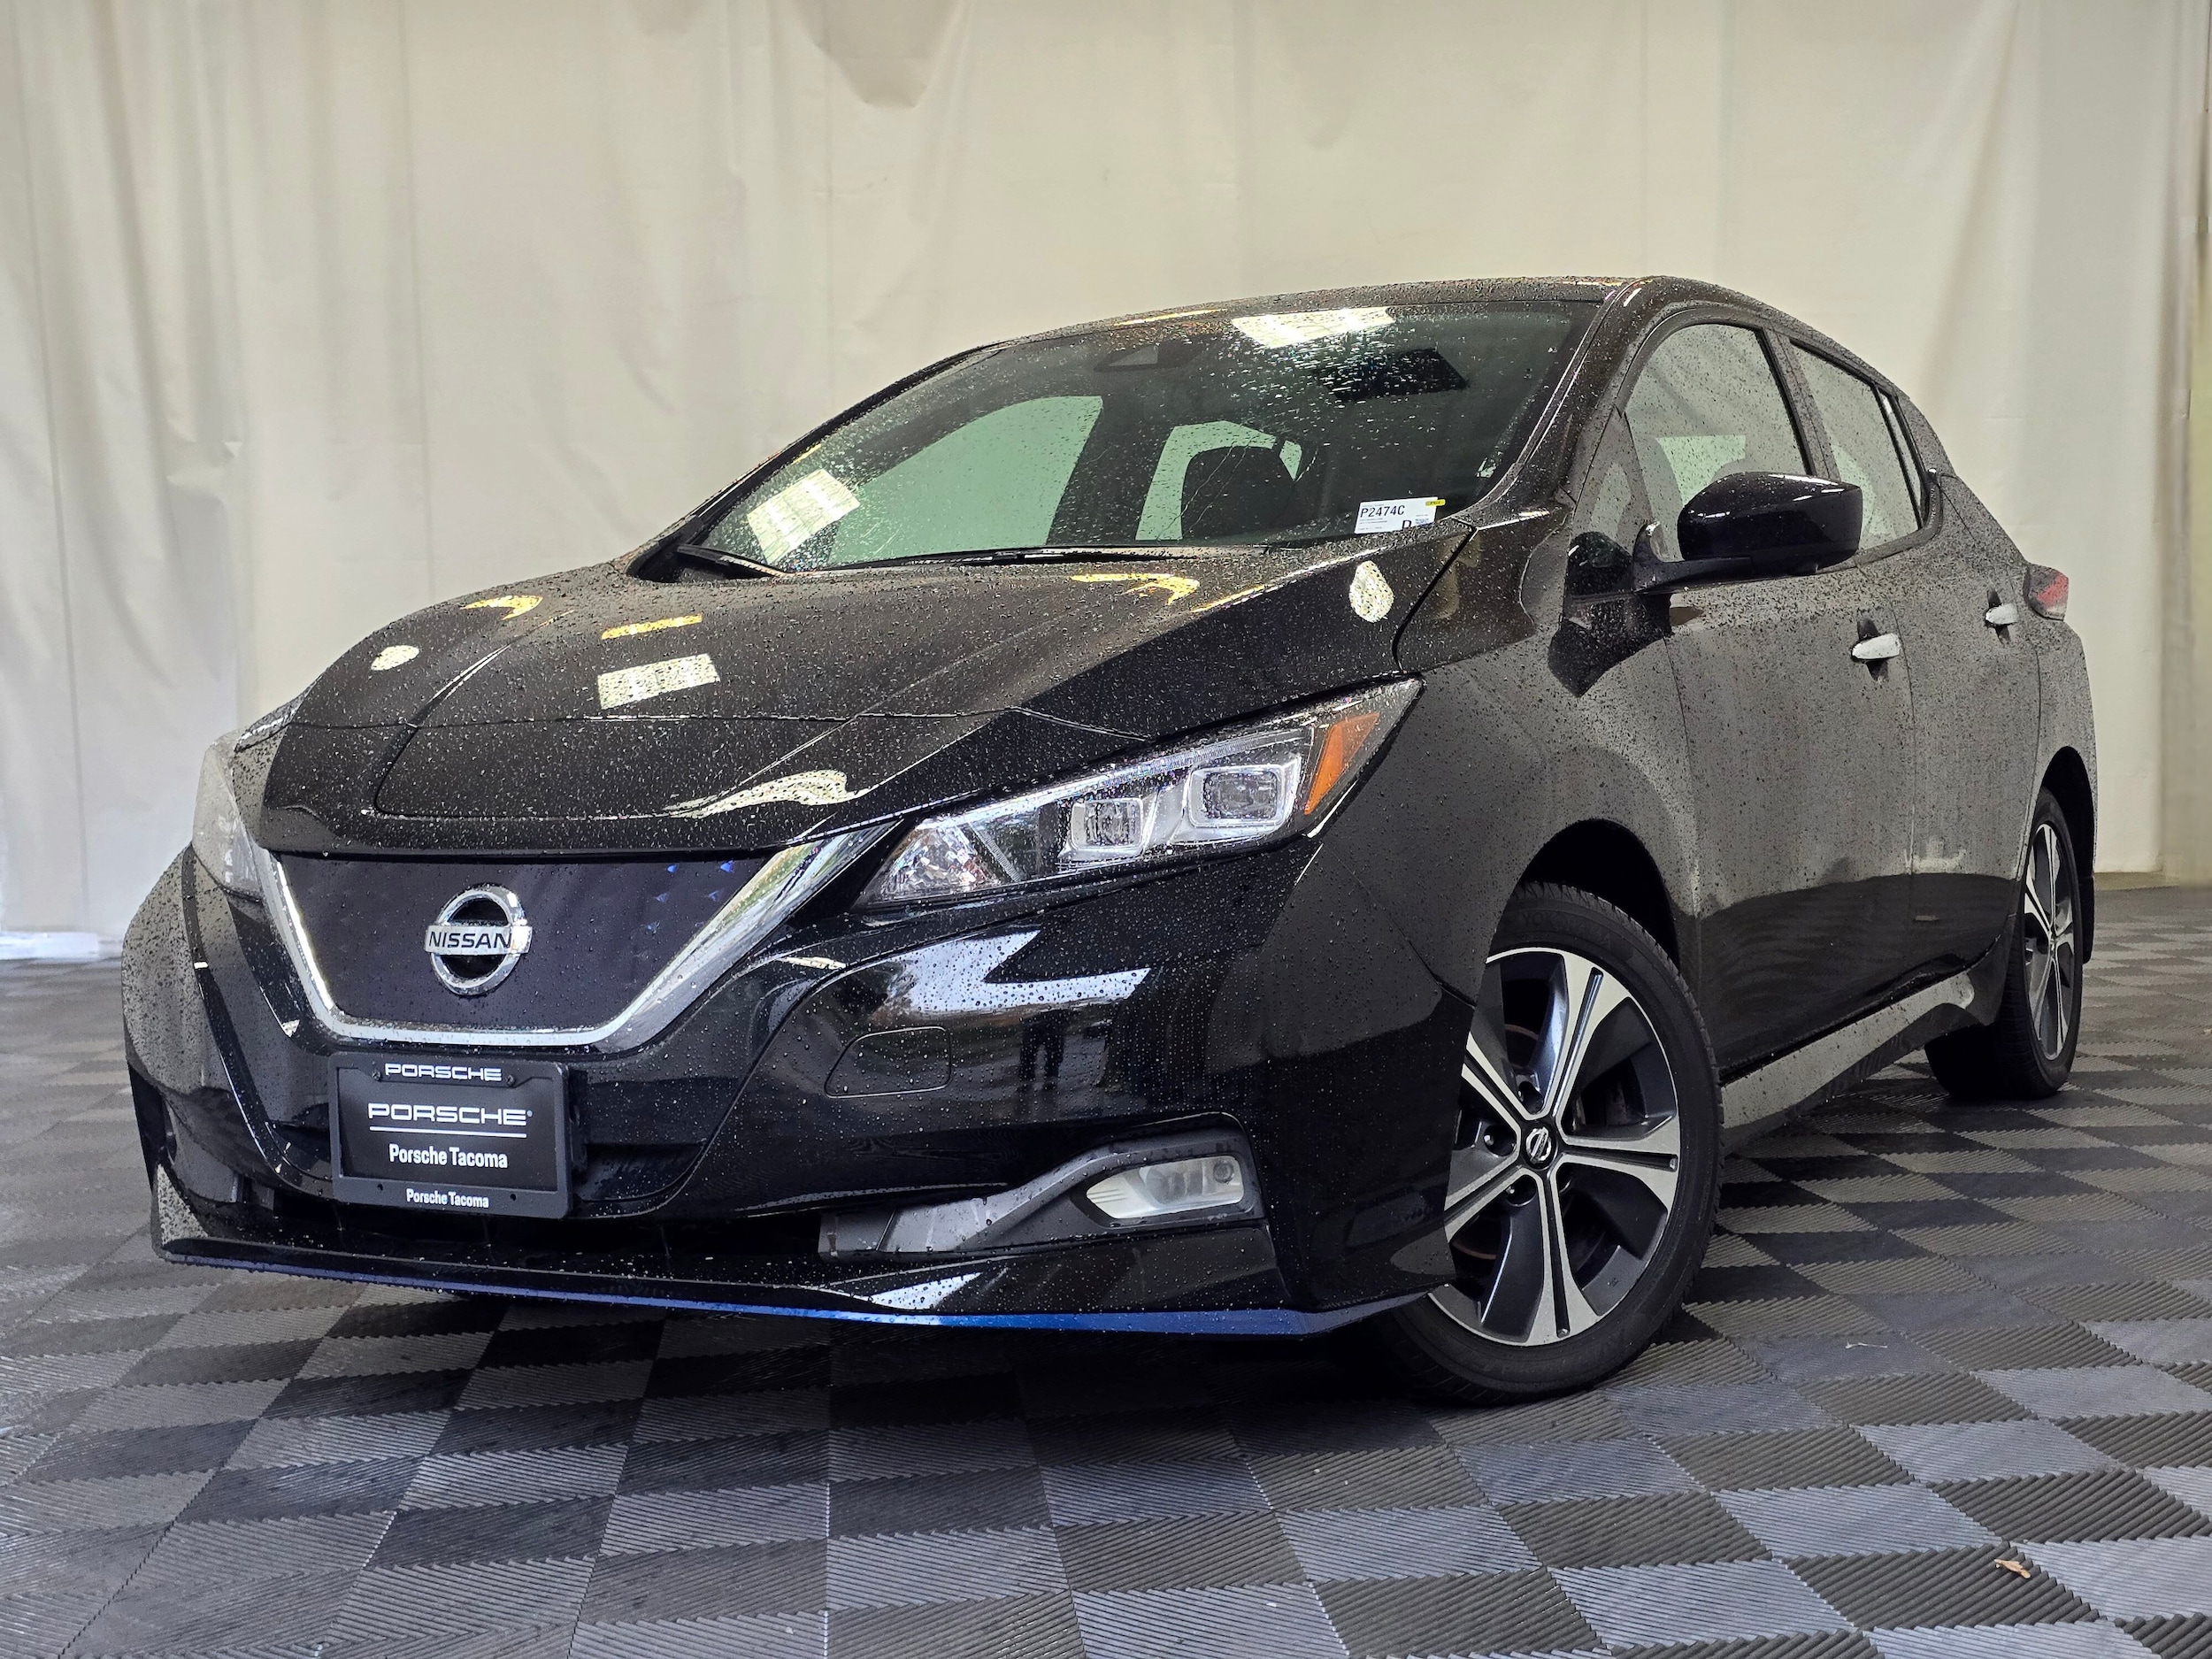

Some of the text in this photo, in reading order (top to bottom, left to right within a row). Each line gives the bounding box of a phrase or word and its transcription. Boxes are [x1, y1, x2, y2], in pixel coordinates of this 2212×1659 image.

[1360, 505, 1405, 518] P2474C
[429, 932, 512, 949] NISSAN
[385, 1064, 503, 1082] PORSCHE
[389, 1143, 509, 1169] Porsche Tacoma
[406, 1188, 489, 1209] Porsche Tacoma
